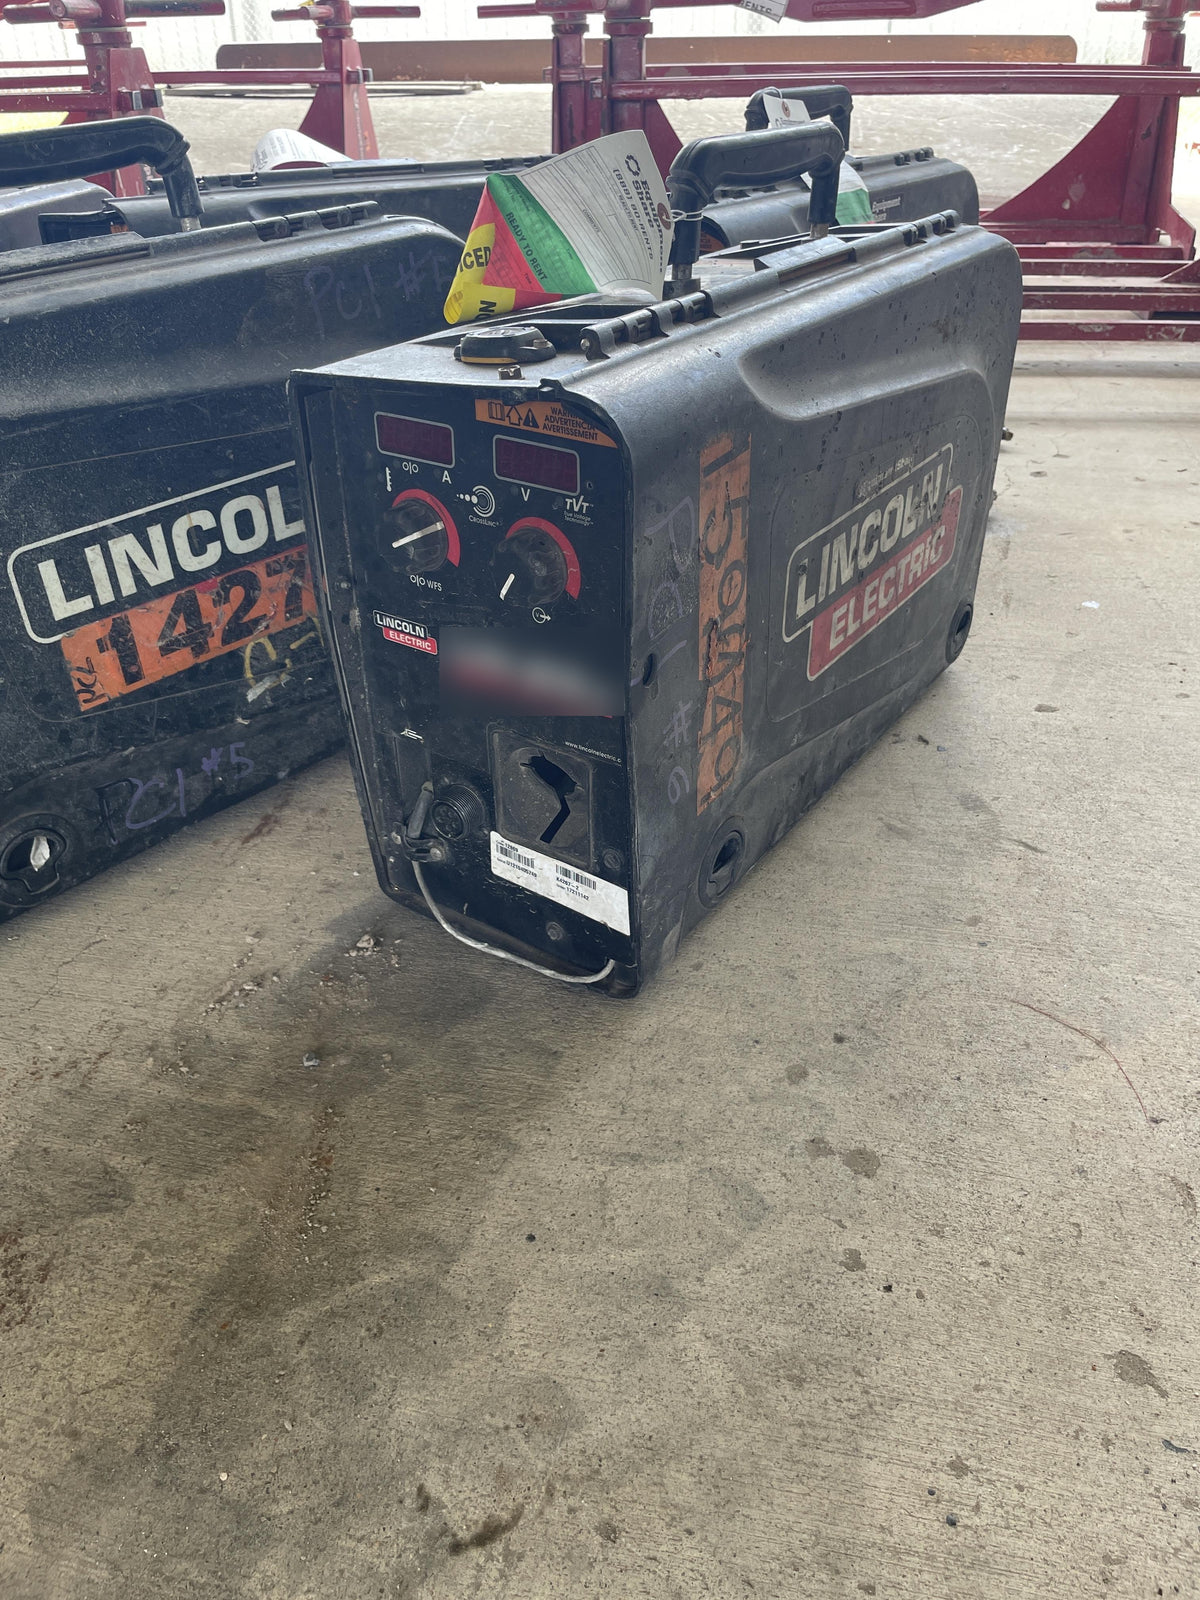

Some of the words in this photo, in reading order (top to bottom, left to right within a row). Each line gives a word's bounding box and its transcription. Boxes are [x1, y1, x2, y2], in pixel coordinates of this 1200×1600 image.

[632, 180, 655, 229] Share
[640, 180, 664, 273] Equipment
[506, 212, 527, 243] READY
[523, 243, 534, 258] TO
[529, 258, 548, 281] RENT
[542, 423, 599, 441] AVERTISSEMENT
[442, 470, 452, 485] A
[520, 487, 532, 502] V
[796, 463, 944, 620] LINCOLN
[426, 579, 442, 592] WFS
[829, 525, 946, 651] ELECTRIC
[97, 551, 308, 687] 1427
[376, 613, 425, 638] LINCOLN
[389, 631, 432, 651] ELECTRIC
